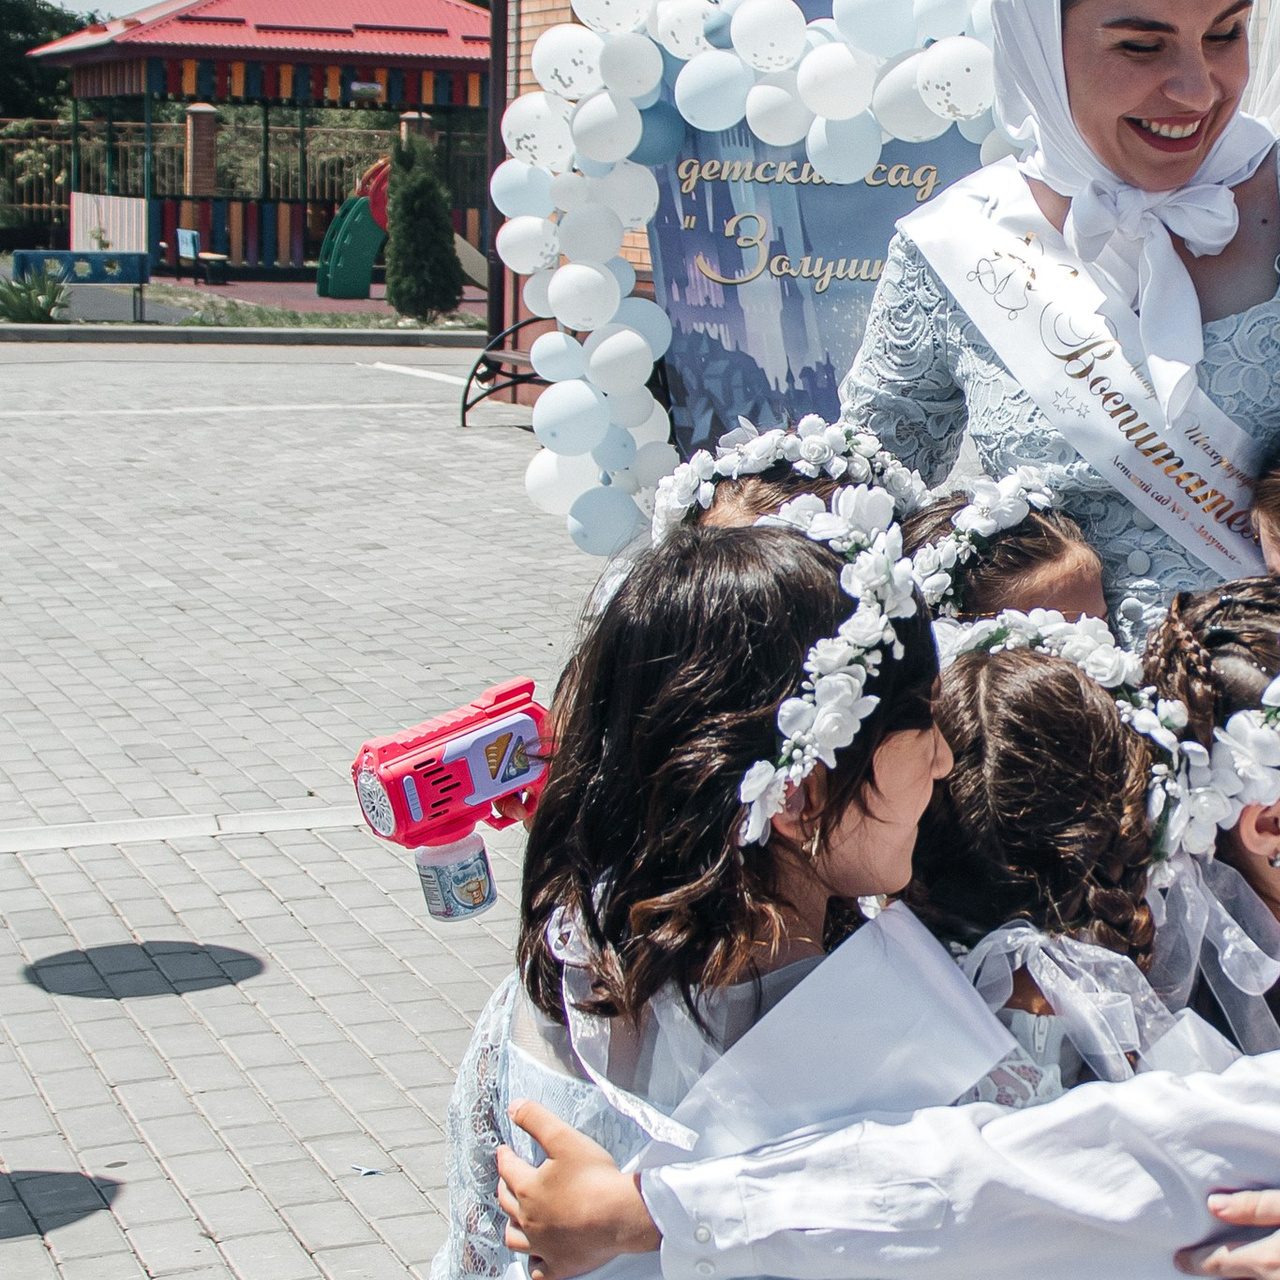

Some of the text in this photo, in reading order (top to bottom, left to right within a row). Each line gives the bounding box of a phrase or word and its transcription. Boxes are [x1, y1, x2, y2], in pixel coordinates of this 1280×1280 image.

[677, 158, 942, 203] детски сад
[1150, 488, 1171, 508] сад
